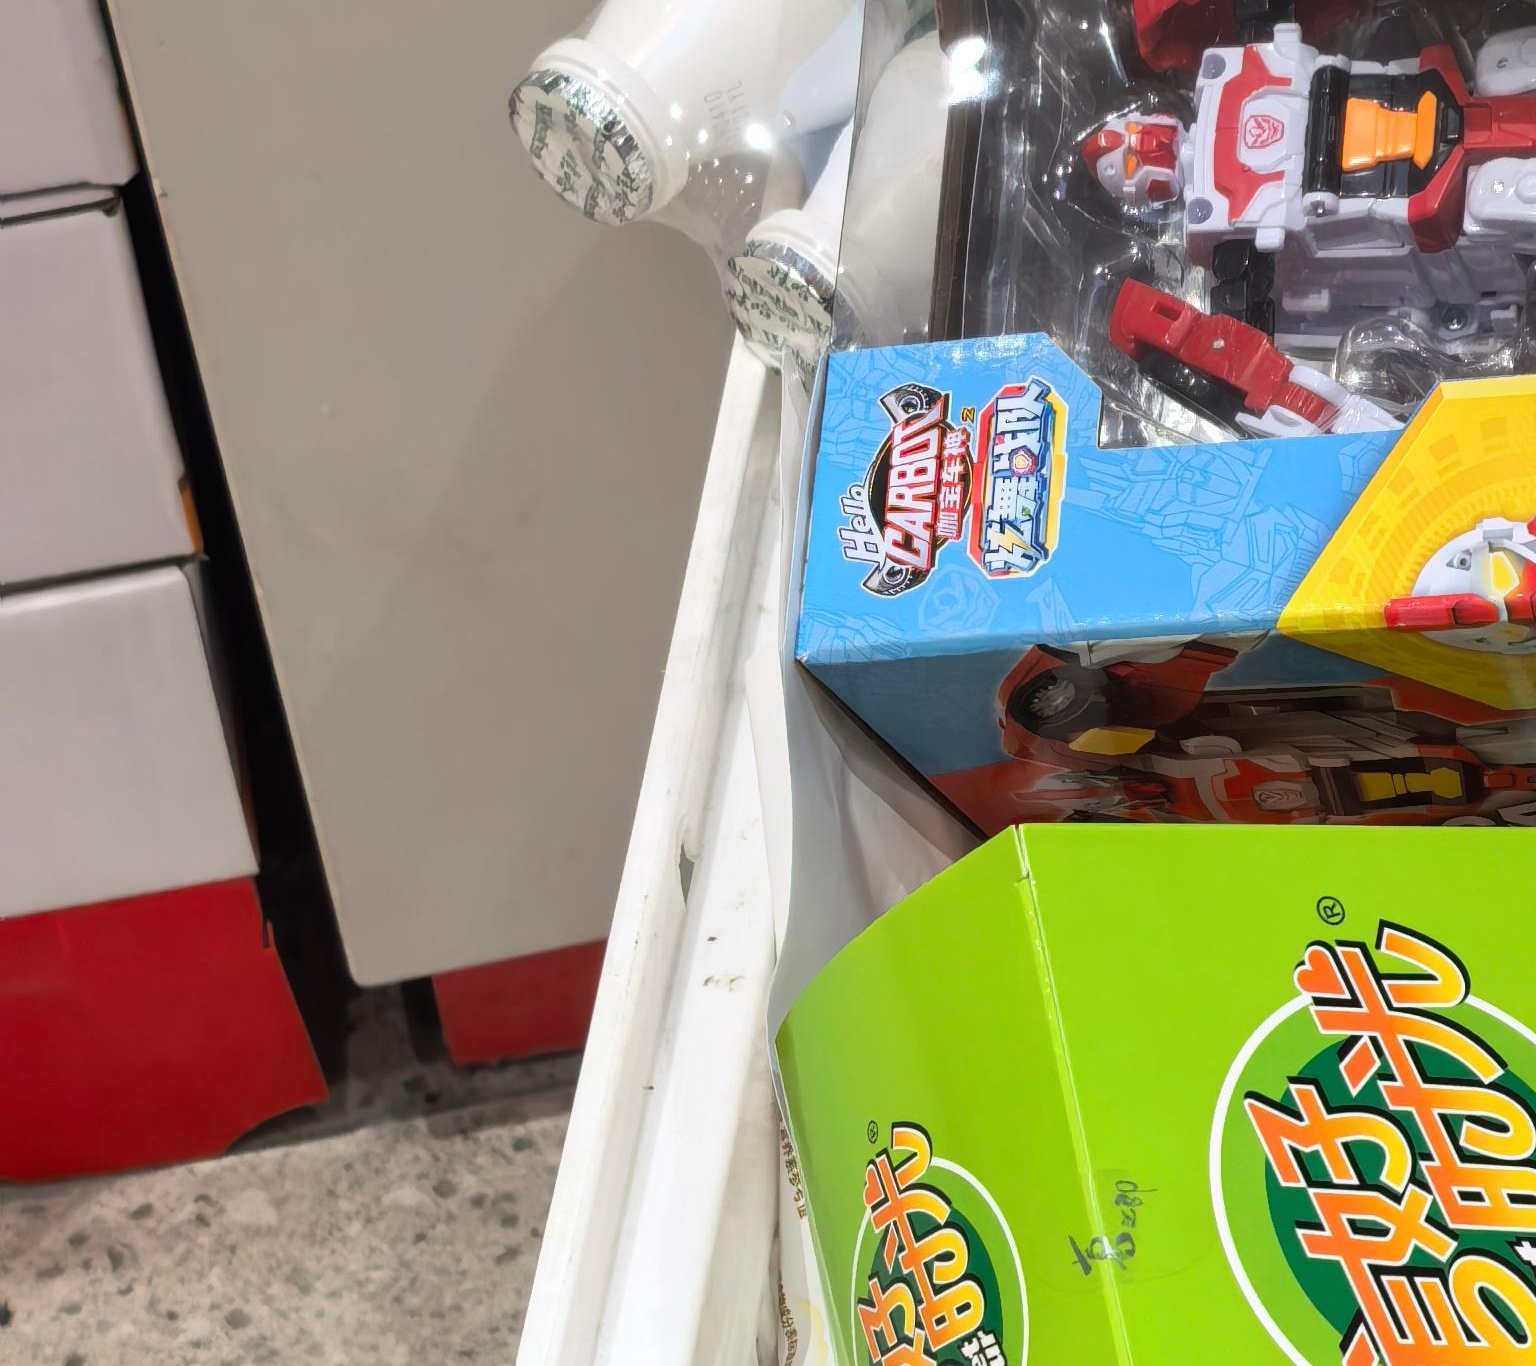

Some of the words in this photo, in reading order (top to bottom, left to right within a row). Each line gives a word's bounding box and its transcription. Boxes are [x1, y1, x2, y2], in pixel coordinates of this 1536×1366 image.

[838, 483, 886, 565] Hello
[884, 401, 944, 570] CARBOT
[937, 428, 967, 538] 咖宝车神
